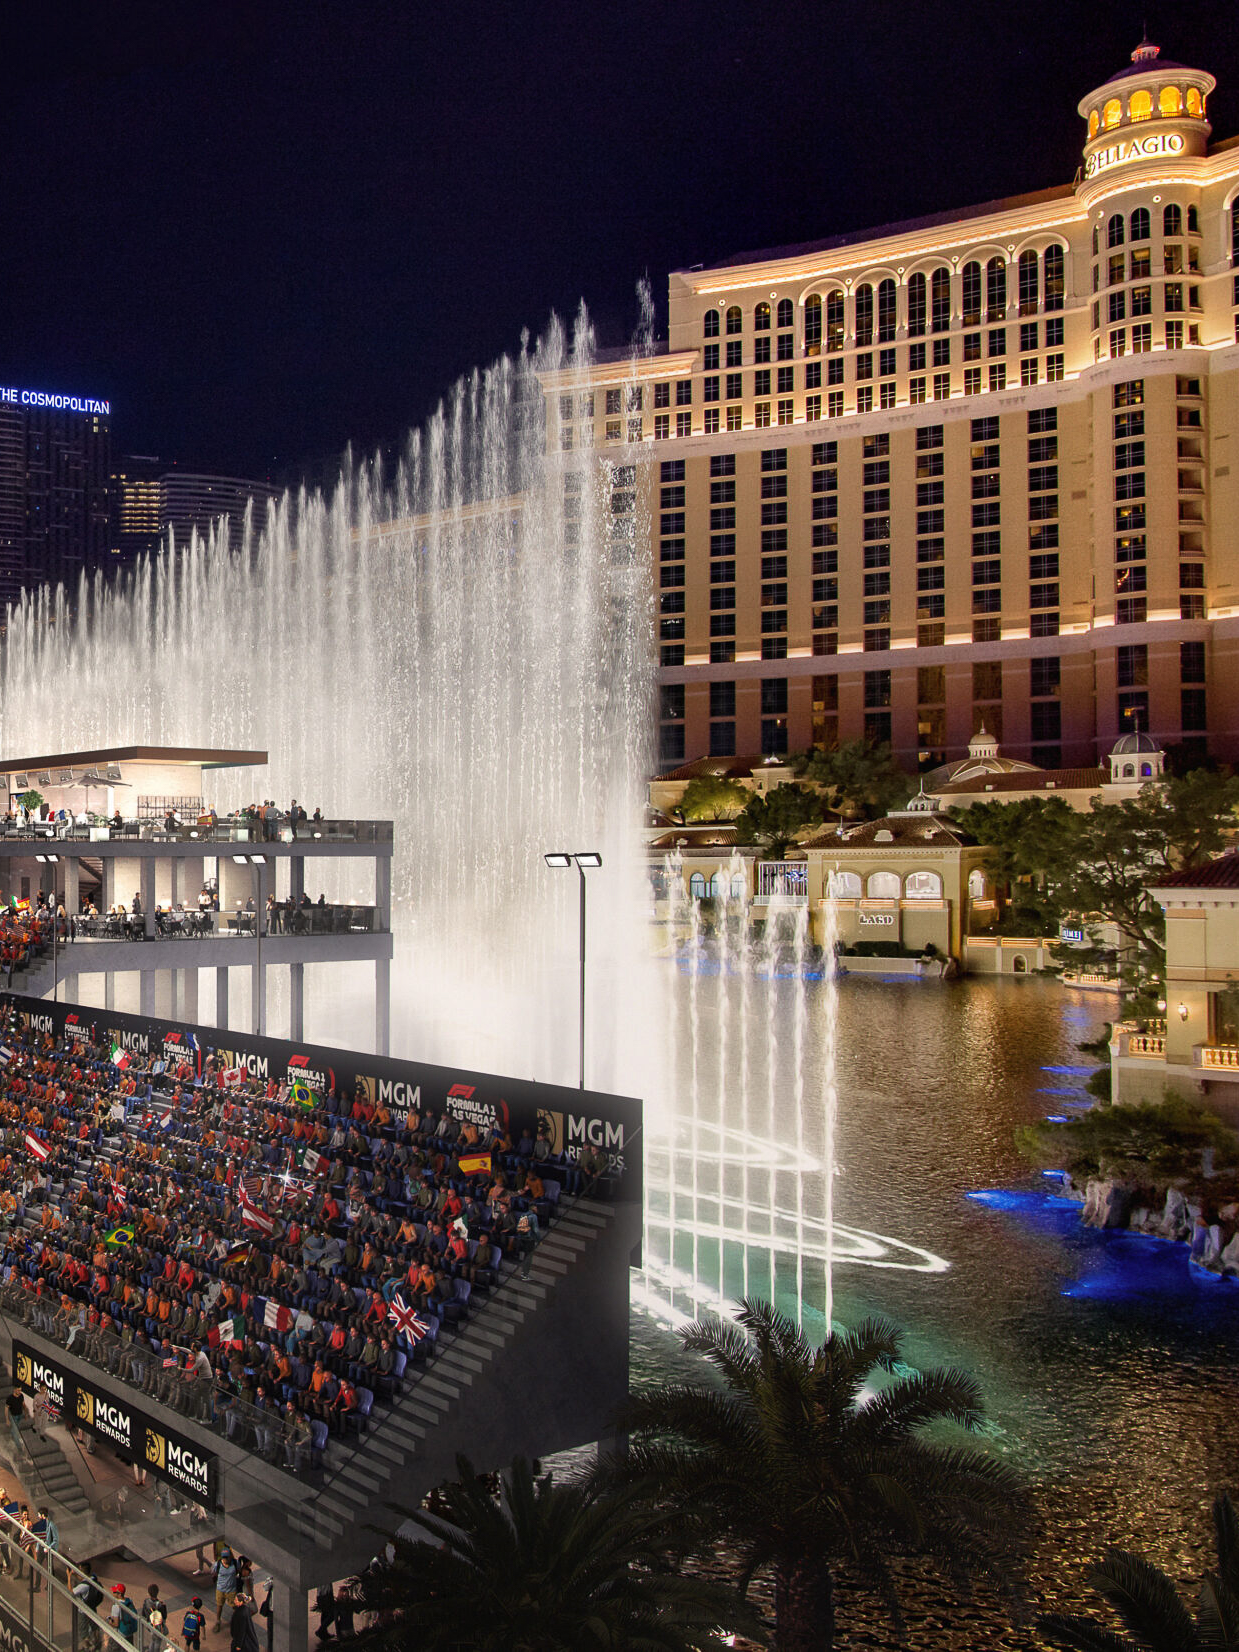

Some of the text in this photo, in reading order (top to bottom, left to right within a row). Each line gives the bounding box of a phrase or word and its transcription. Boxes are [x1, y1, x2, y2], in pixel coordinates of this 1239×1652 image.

[1085, 134, 1185, 180] BELLAGIO
[21, 391, 110, 415] COSMOPOLITAN
[31, 1014, 53, 1034] MGM
[122, 1031, 149, 1053] MGM
[236, 1052, 268, 1078] MGM
[287, 1066, 320, 1081] FORMULA
[379, 1079, 421, 1109] MGM
[447, 1096, 488, 1115] FORMULA
[568, 1114, 624, 1150] MGM
[568, 1145, 624, 1167] REDS
[34, 1361, 64, 1395] MGM
[34, 1381, 64, 1406] REARDS
[96, 1398, 131, 1436] MGM
[96, 1419, 131, 1448] REWARDS
[168, 1440, 208, 1483] MGM
[168, 1463, 208, 1496] REWARDS
